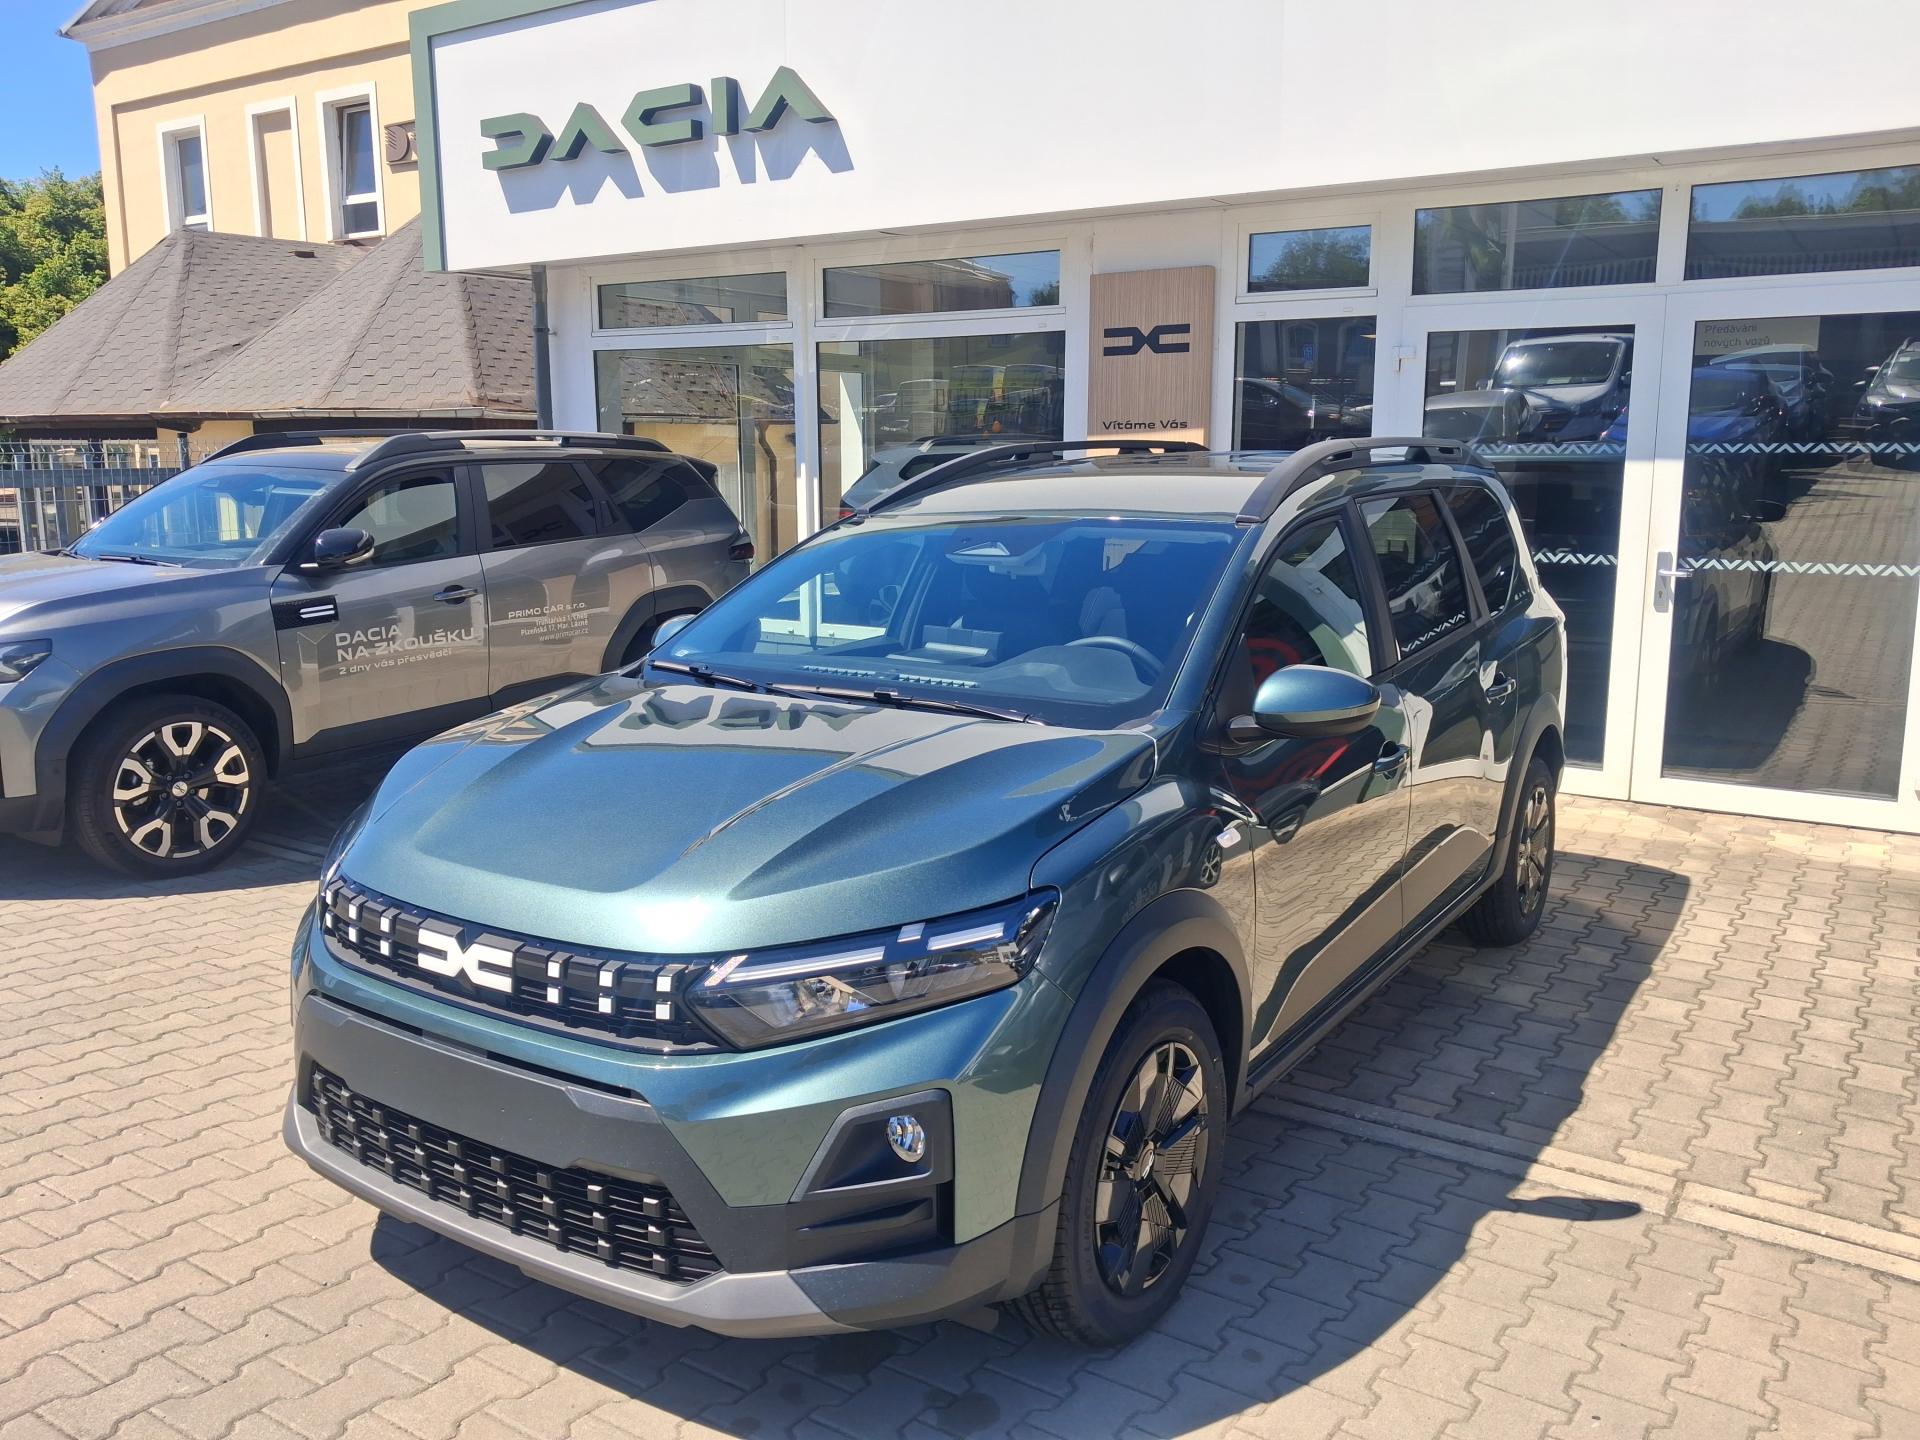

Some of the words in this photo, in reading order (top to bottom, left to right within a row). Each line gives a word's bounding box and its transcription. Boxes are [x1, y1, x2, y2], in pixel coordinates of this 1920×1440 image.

[480, 65, 837, 171] DACIA
[1704, 337, 1742, 348] nových
[1102, 420, 1156, 430] Vítáme
[1159, 419, 1188, 429] Vás
[508, 608, 541, 619] PRIMO
[543, 604, 564, 614] CAR
[335, 624, 402, 647] DACIA
[337, 645, 370, 663] NA
[375, 627, 475, 656] ZKOUŠKU
[339, 666, 347, 675] 2
[350, 662, 371, 674] dny
[374, 657, 395, 668] vás
